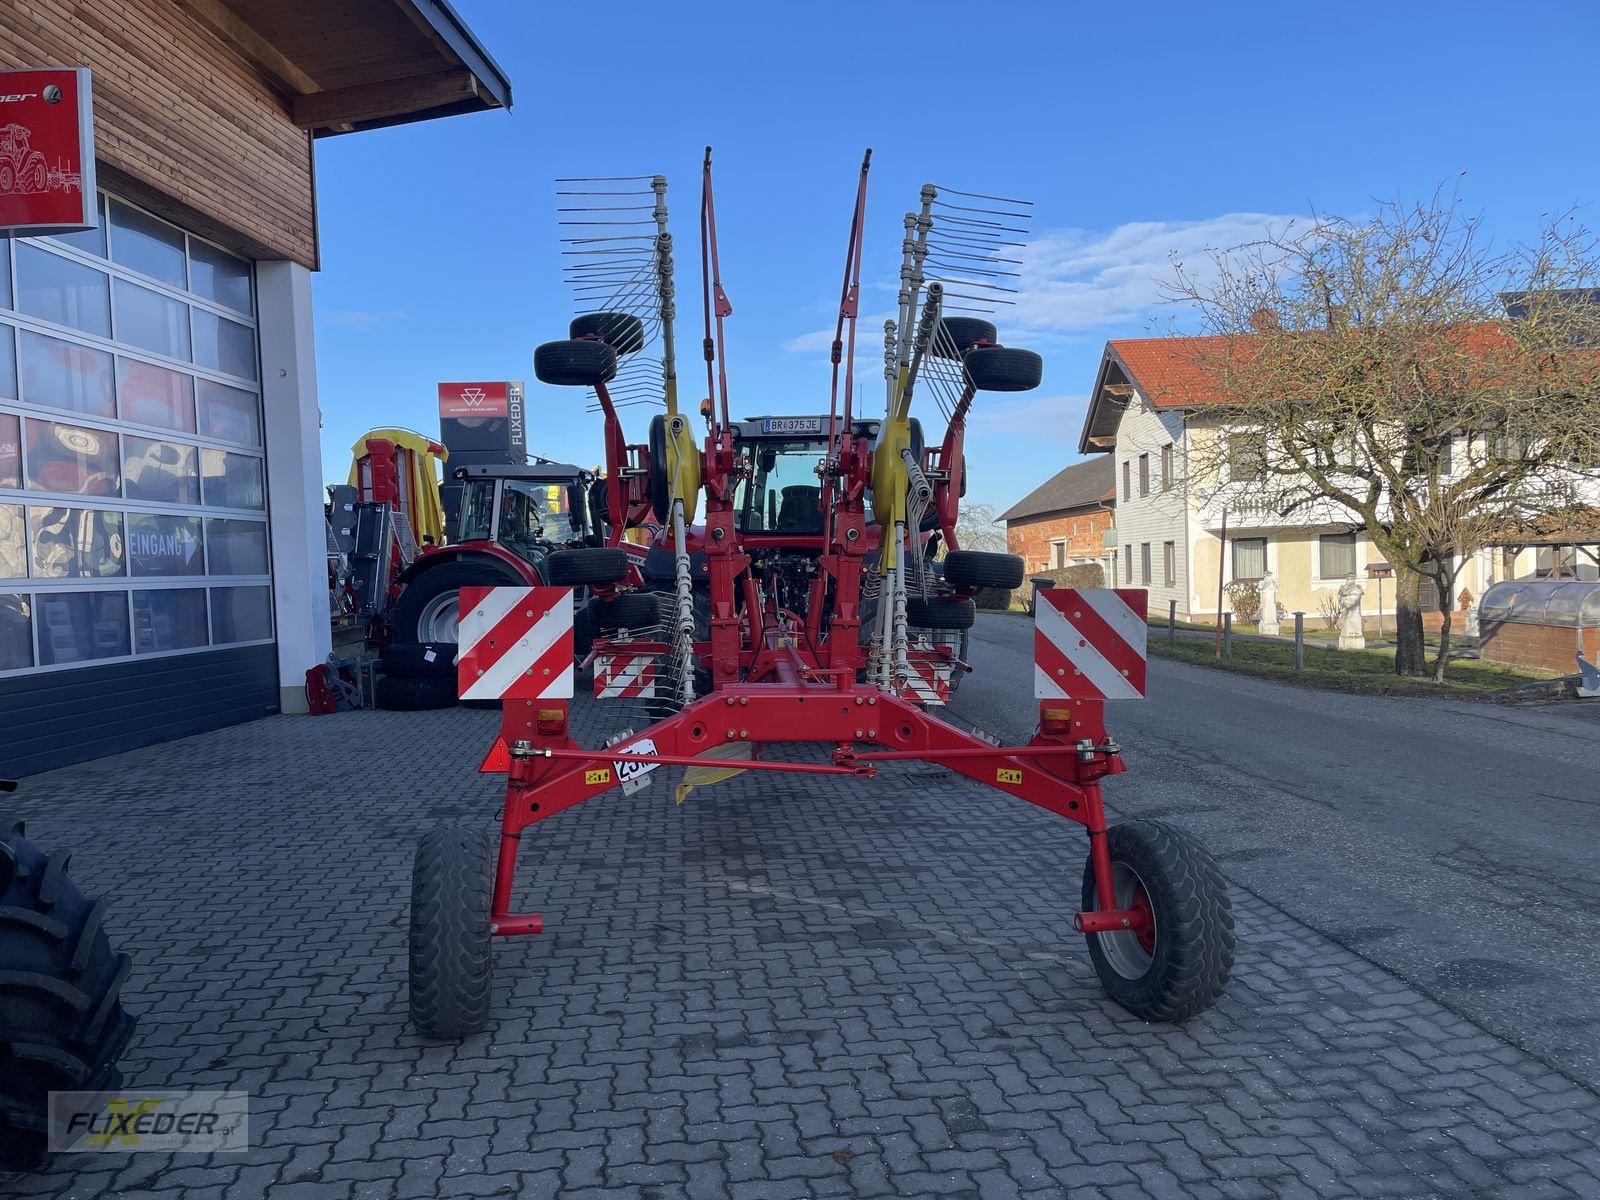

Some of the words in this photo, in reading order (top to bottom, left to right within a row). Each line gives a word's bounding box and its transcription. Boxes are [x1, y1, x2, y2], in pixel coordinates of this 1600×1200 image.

[510, 387, 522, 445] FLIXEDER
[771, 421, 784, 430] BR
[129, 533, 182, 556] EINGANG
